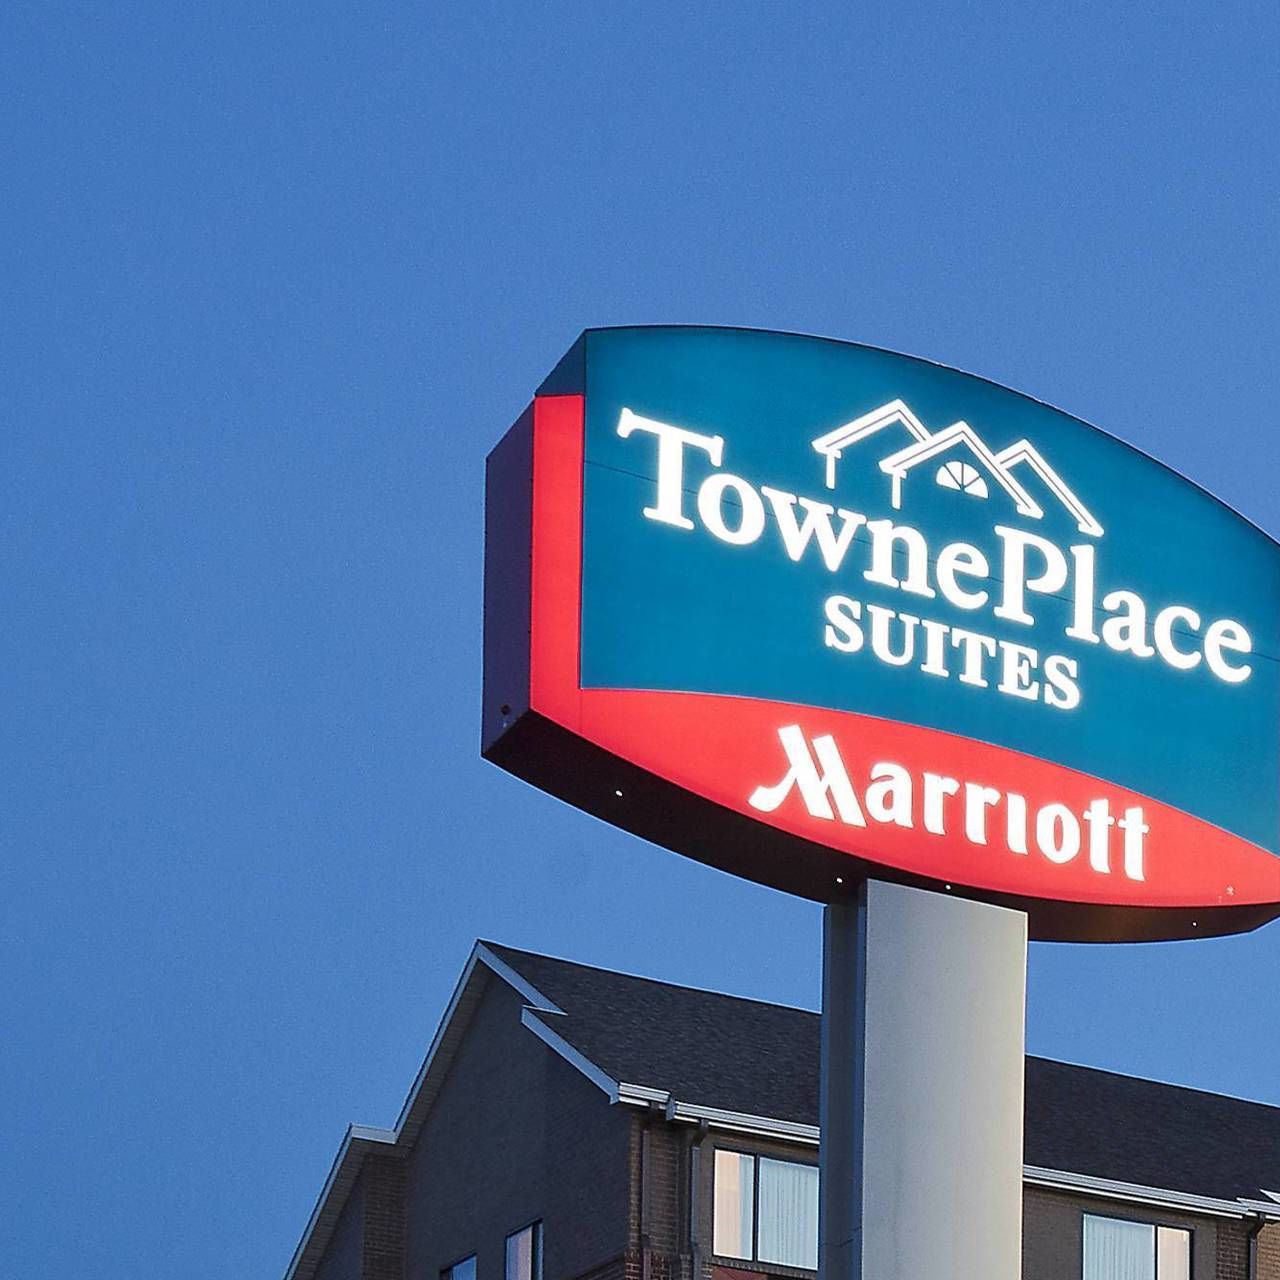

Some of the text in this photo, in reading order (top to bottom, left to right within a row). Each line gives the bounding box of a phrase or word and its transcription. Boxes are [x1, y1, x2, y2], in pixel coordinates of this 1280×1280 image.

[616, 406, 1253, 684] TownePlace
[824, 594, 1081, 711] SUITES
[747, 723, 1150, 882] Marriott
